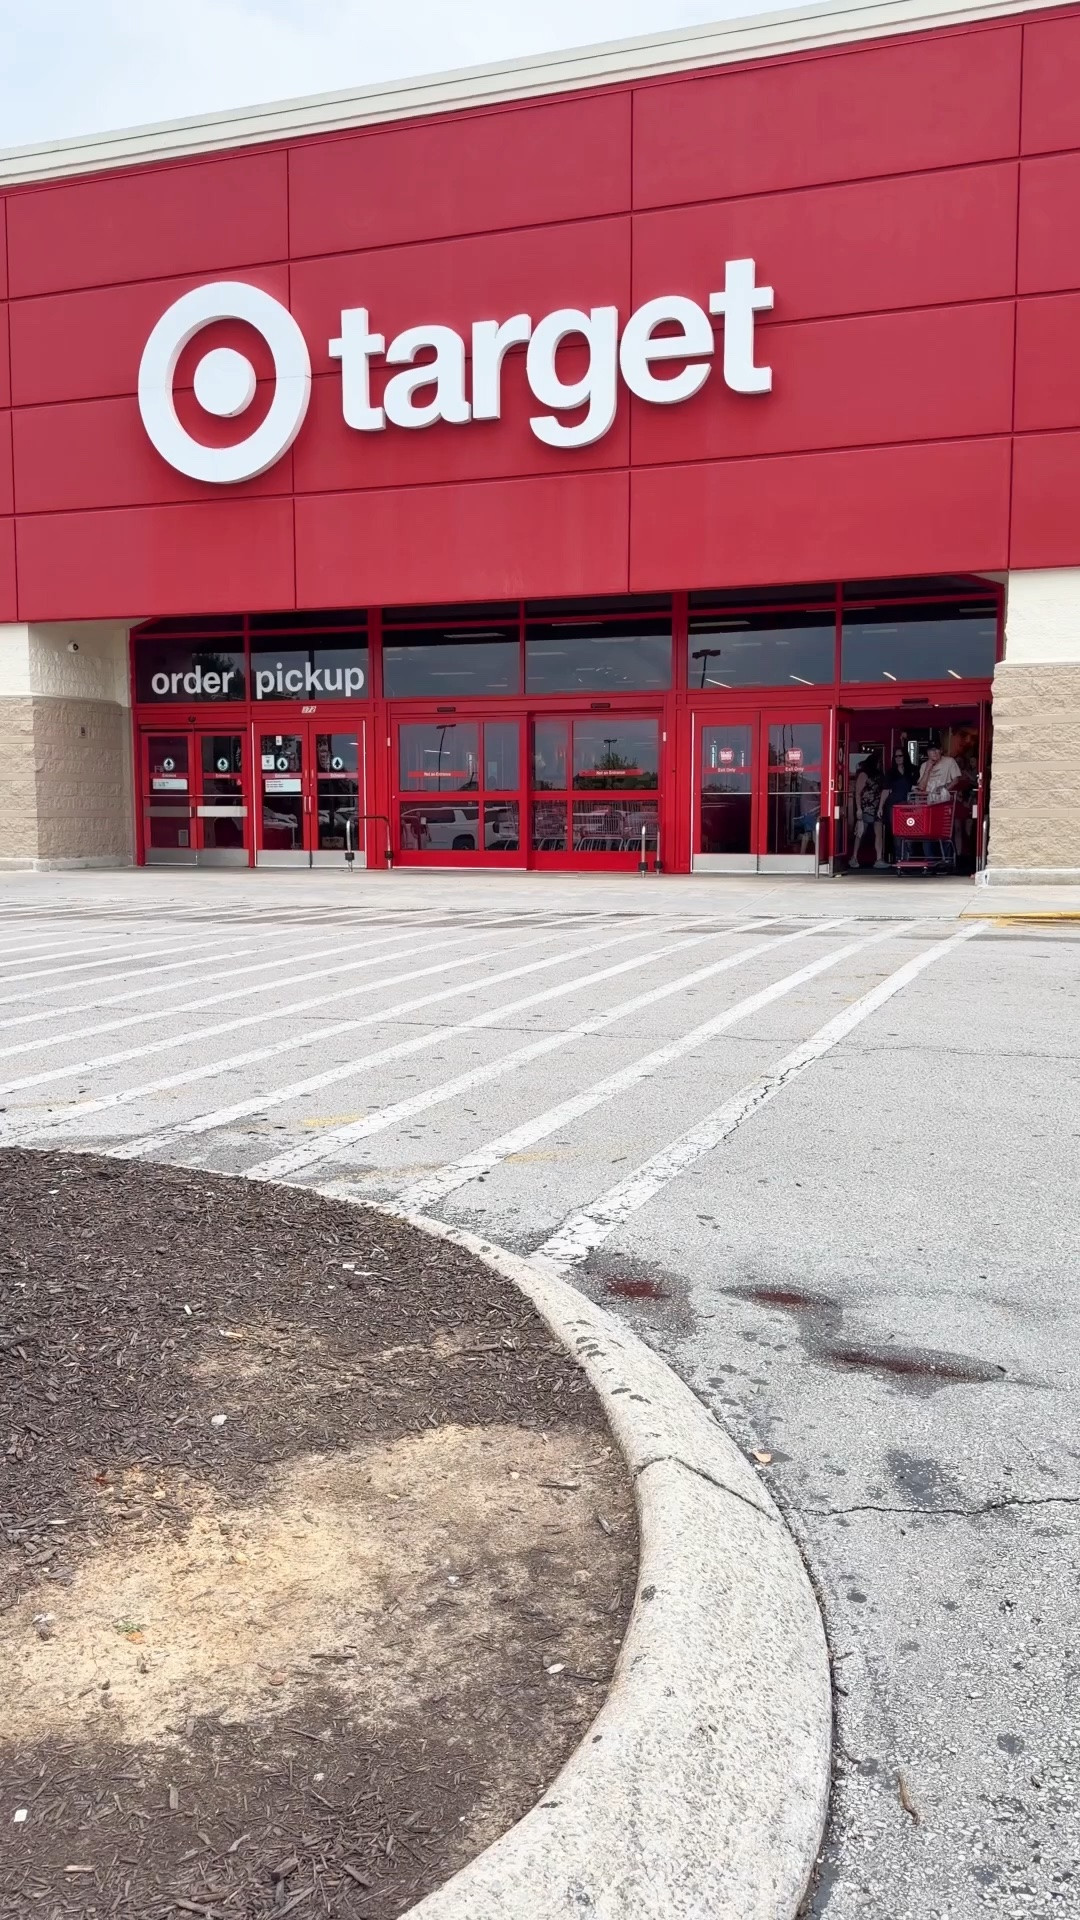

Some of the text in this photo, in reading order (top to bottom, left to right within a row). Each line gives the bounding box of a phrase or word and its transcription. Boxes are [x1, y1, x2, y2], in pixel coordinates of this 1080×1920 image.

[328, 258, 775, 448] target
[151, 661, 365, 700] order pickup
